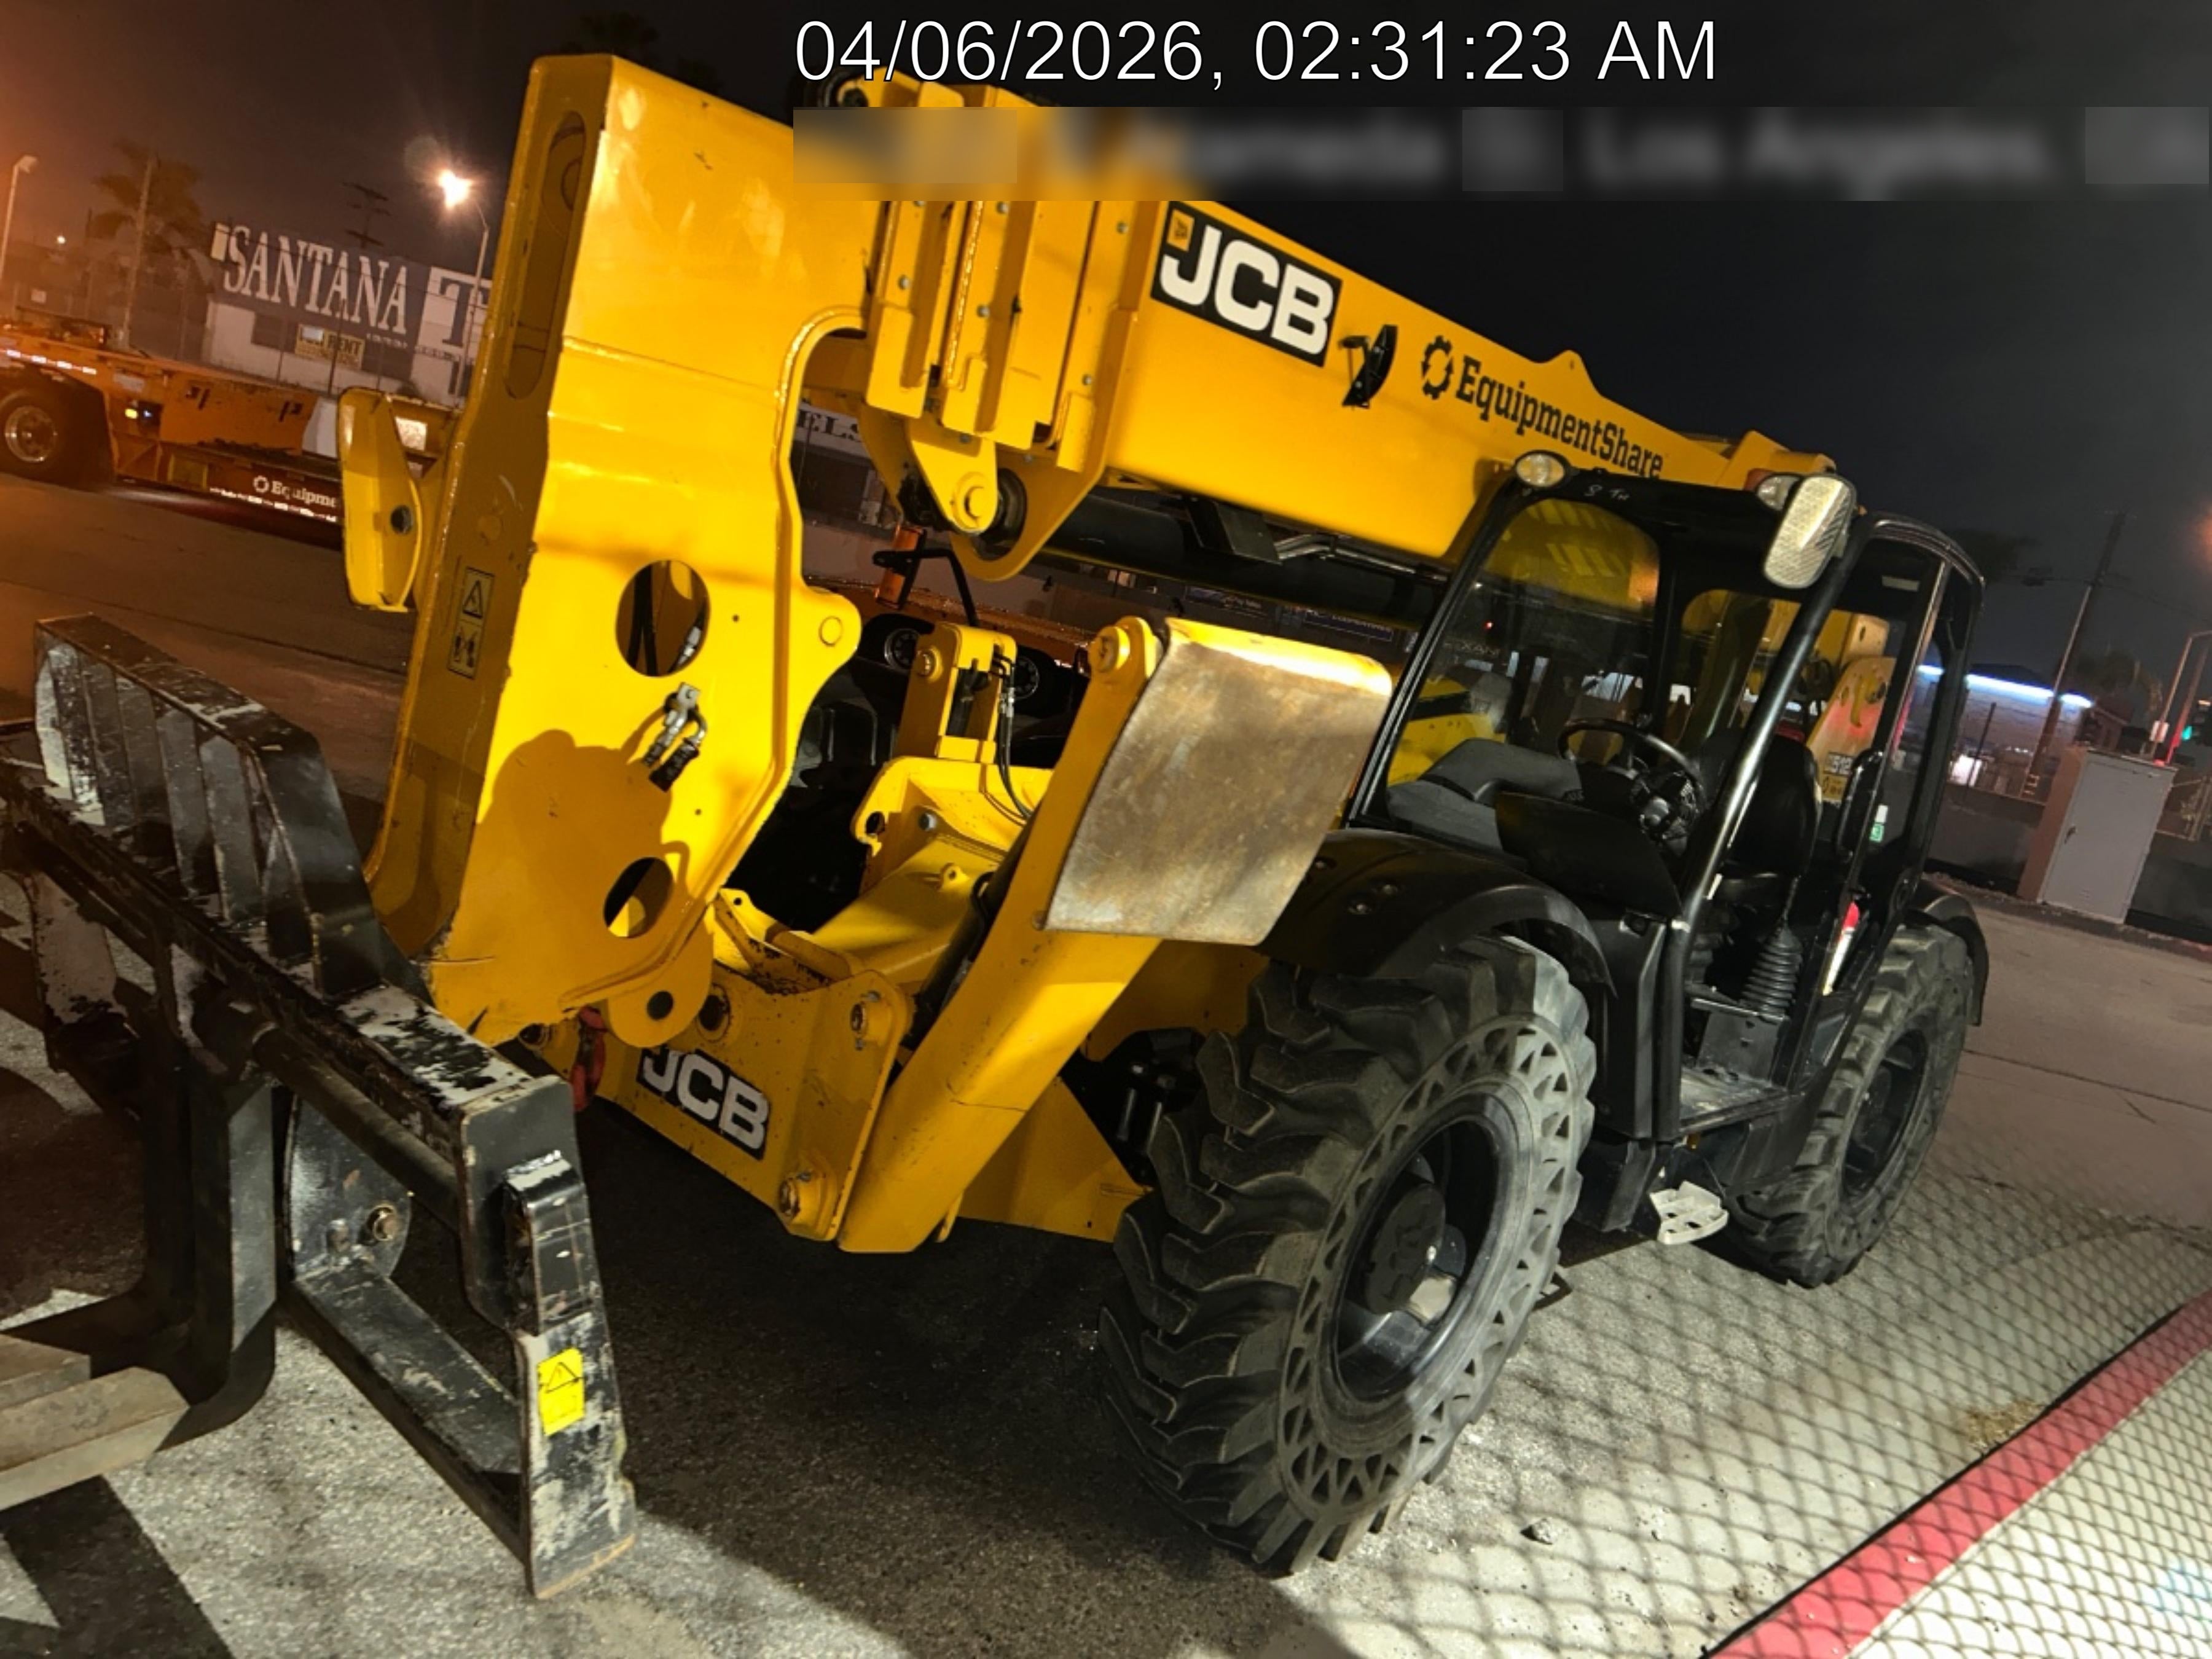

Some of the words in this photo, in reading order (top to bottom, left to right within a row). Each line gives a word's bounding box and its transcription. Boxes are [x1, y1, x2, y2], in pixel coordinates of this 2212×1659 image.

[224, 225, 408, 334] SANTANA
[1159, 224, 1335, 356] JCB
[1455, 356, 1665, 480] EquipmentShare
[643, 1048, 770, 1150] JCB
